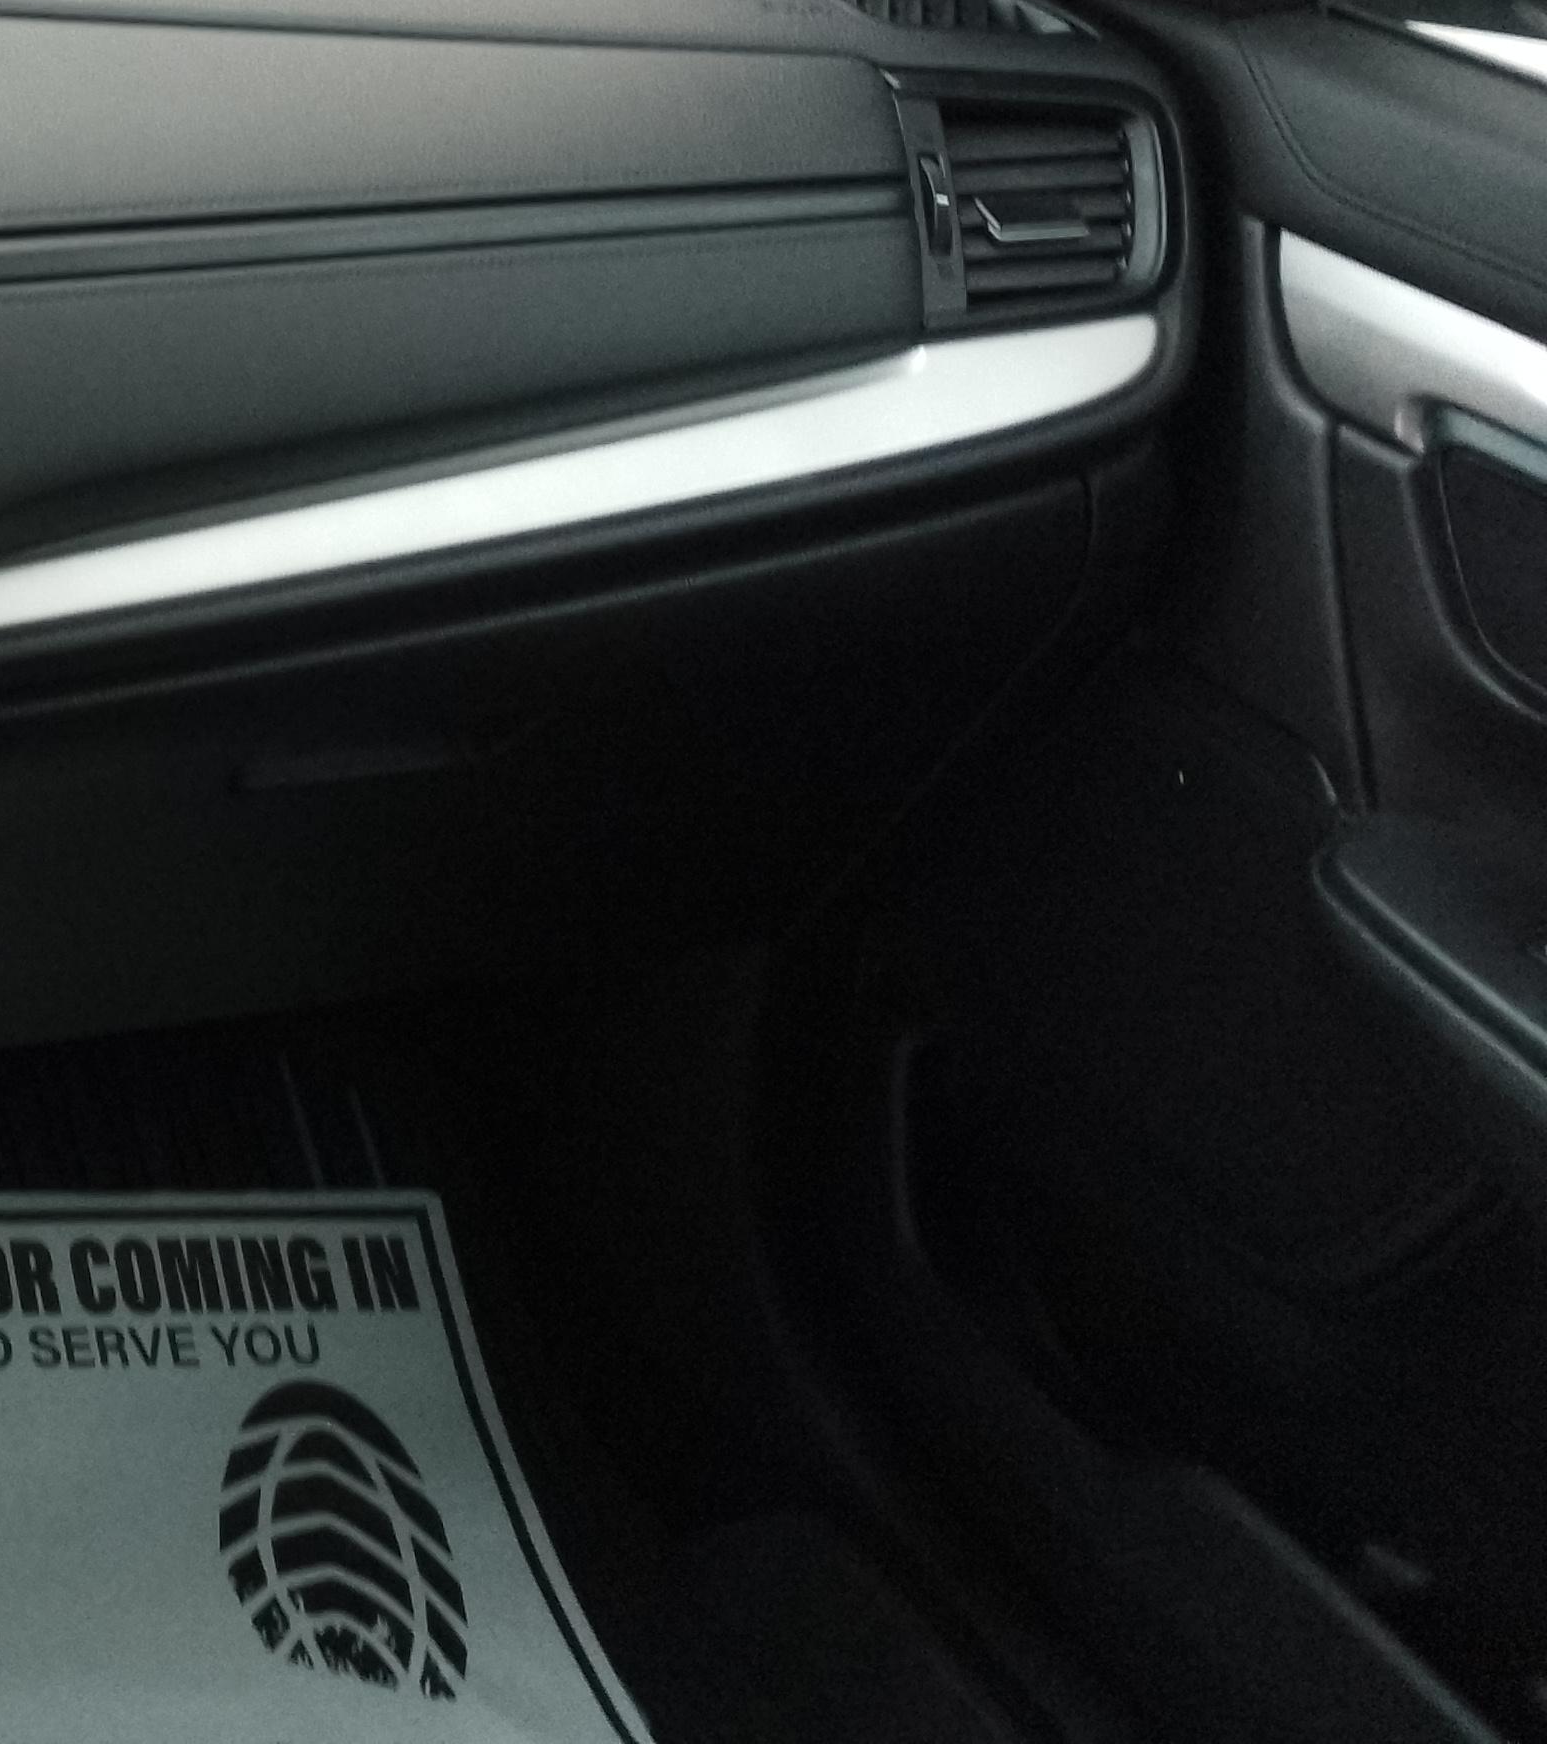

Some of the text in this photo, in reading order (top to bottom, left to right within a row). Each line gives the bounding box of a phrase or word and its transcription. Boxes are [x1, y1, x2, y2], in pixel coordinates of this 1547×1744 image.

[68, 1234, 339, 1315] COMING
[341, 1235, 422, 1313] IN
[27, 1324, 201, 1369] SERVE
[209, 1322, 321, 1368] YOU
